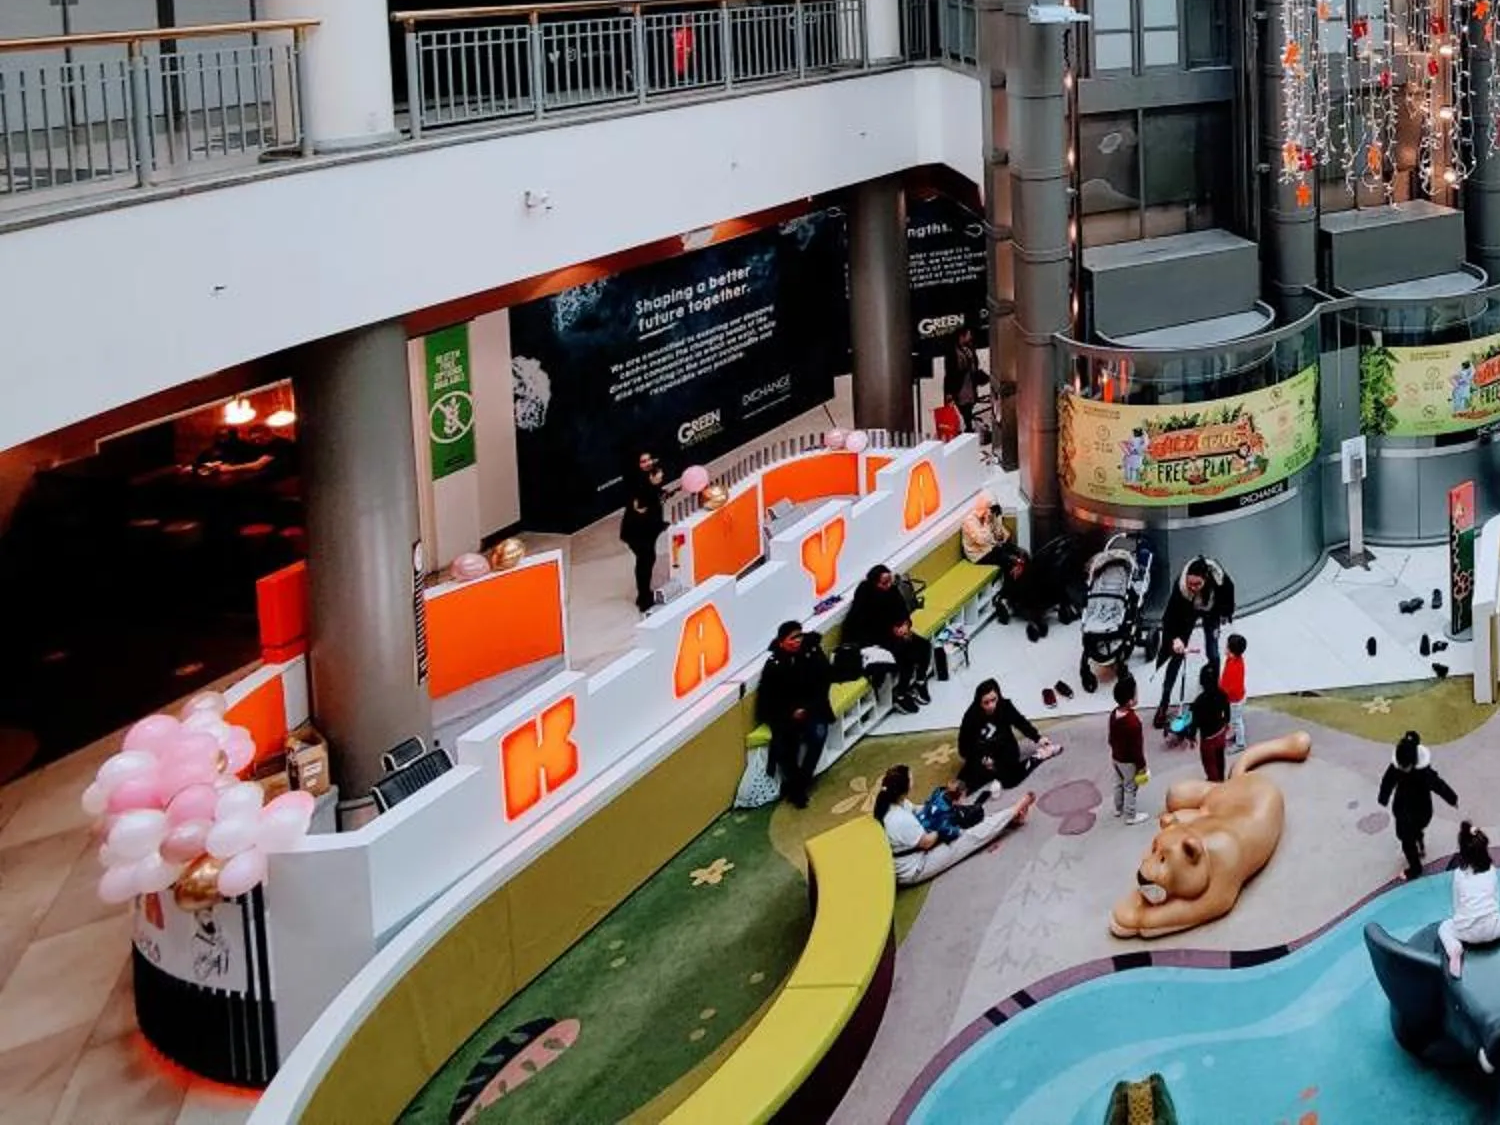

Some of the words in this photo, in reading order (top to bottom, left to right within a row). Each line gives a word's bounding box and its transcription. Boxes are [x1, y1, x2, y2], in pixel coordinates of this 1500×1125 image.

[635, 285, 693, 315] Shaping
[696, 282, 705, 293] a
[709, 266, 751, 289] better
[638, 306, 684, 332] future
[688, 283, 751, 315] together.
[917, 312, 965, 335] GREEN
[677, 408, 721, 444] GREEN
[1156, 460, 1189, 484] FREE
[1203, 458, 1233, 482] PLAY
